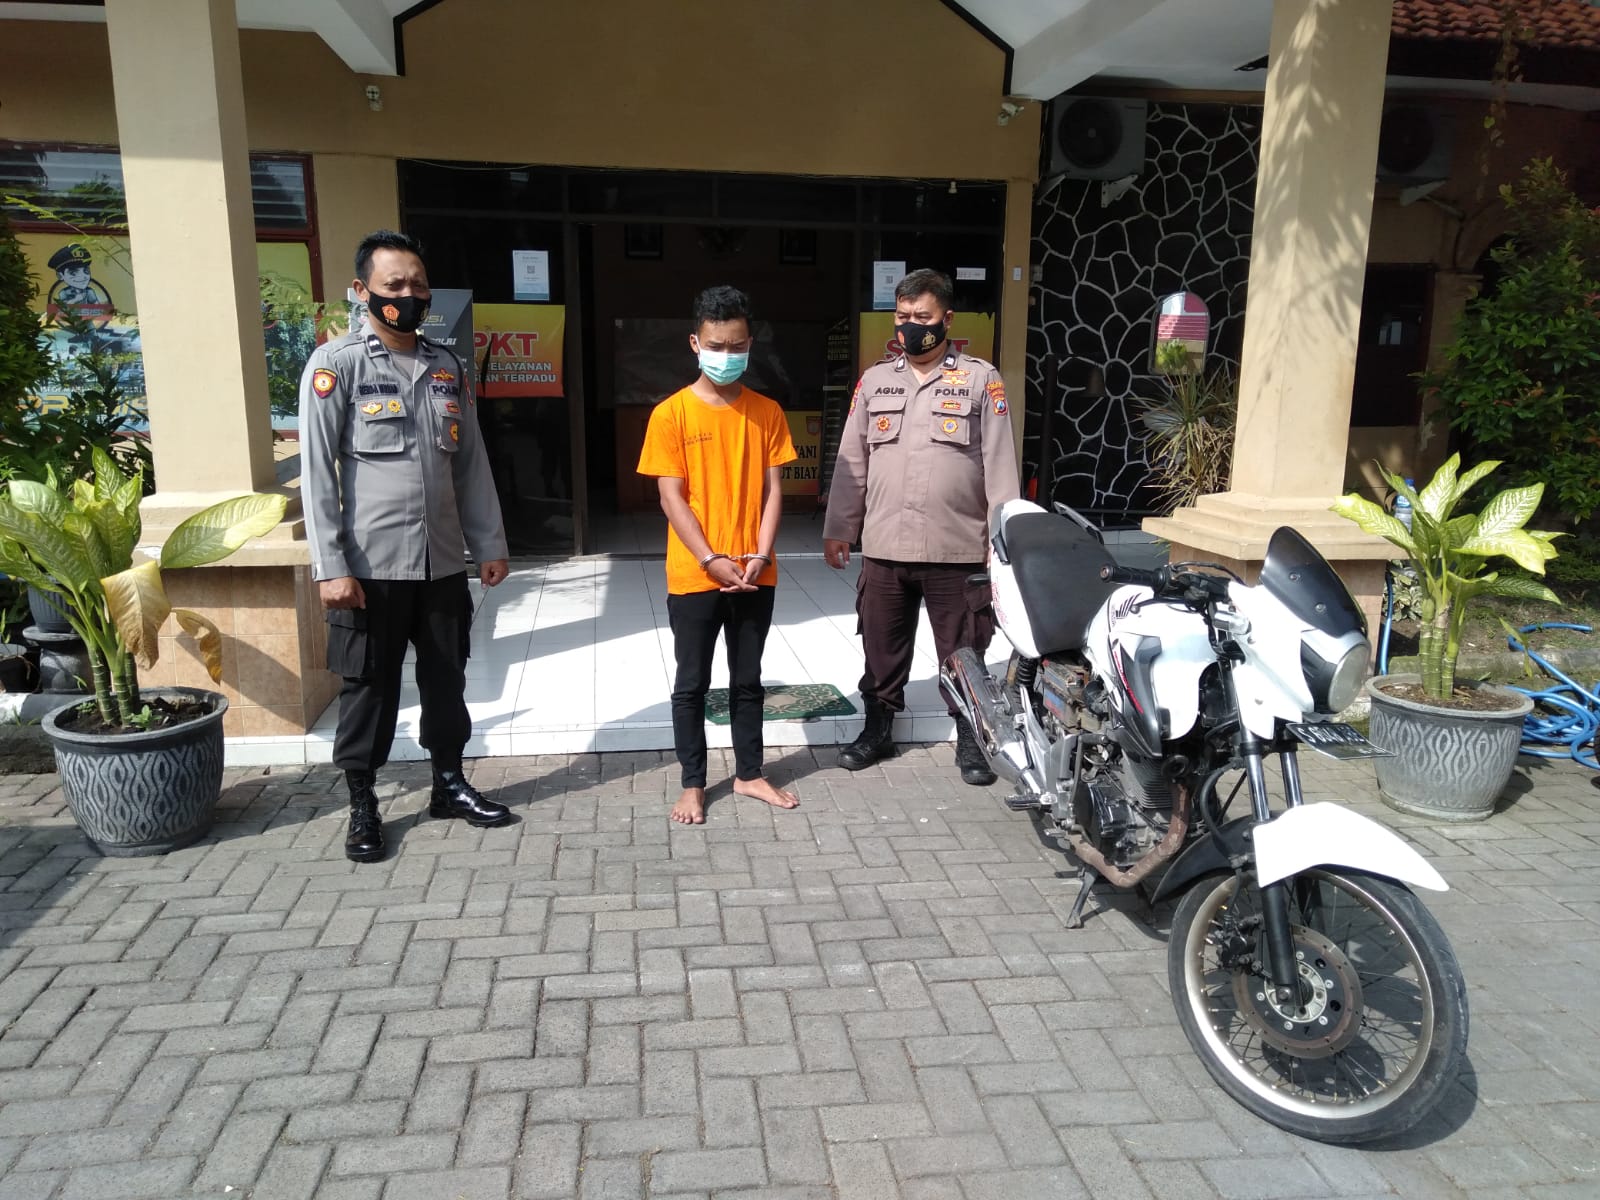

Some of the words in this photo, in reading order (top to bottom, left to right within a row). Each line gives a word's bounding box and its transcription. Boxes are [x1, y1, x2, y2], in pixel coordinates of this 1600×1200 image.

[488, 362, 552, 371] ELAYANAN
[503, 374, 557, 383] TERPADU
[874, 386, 905, 395] AGUS
[935, 388, 970, 397] POLRI
